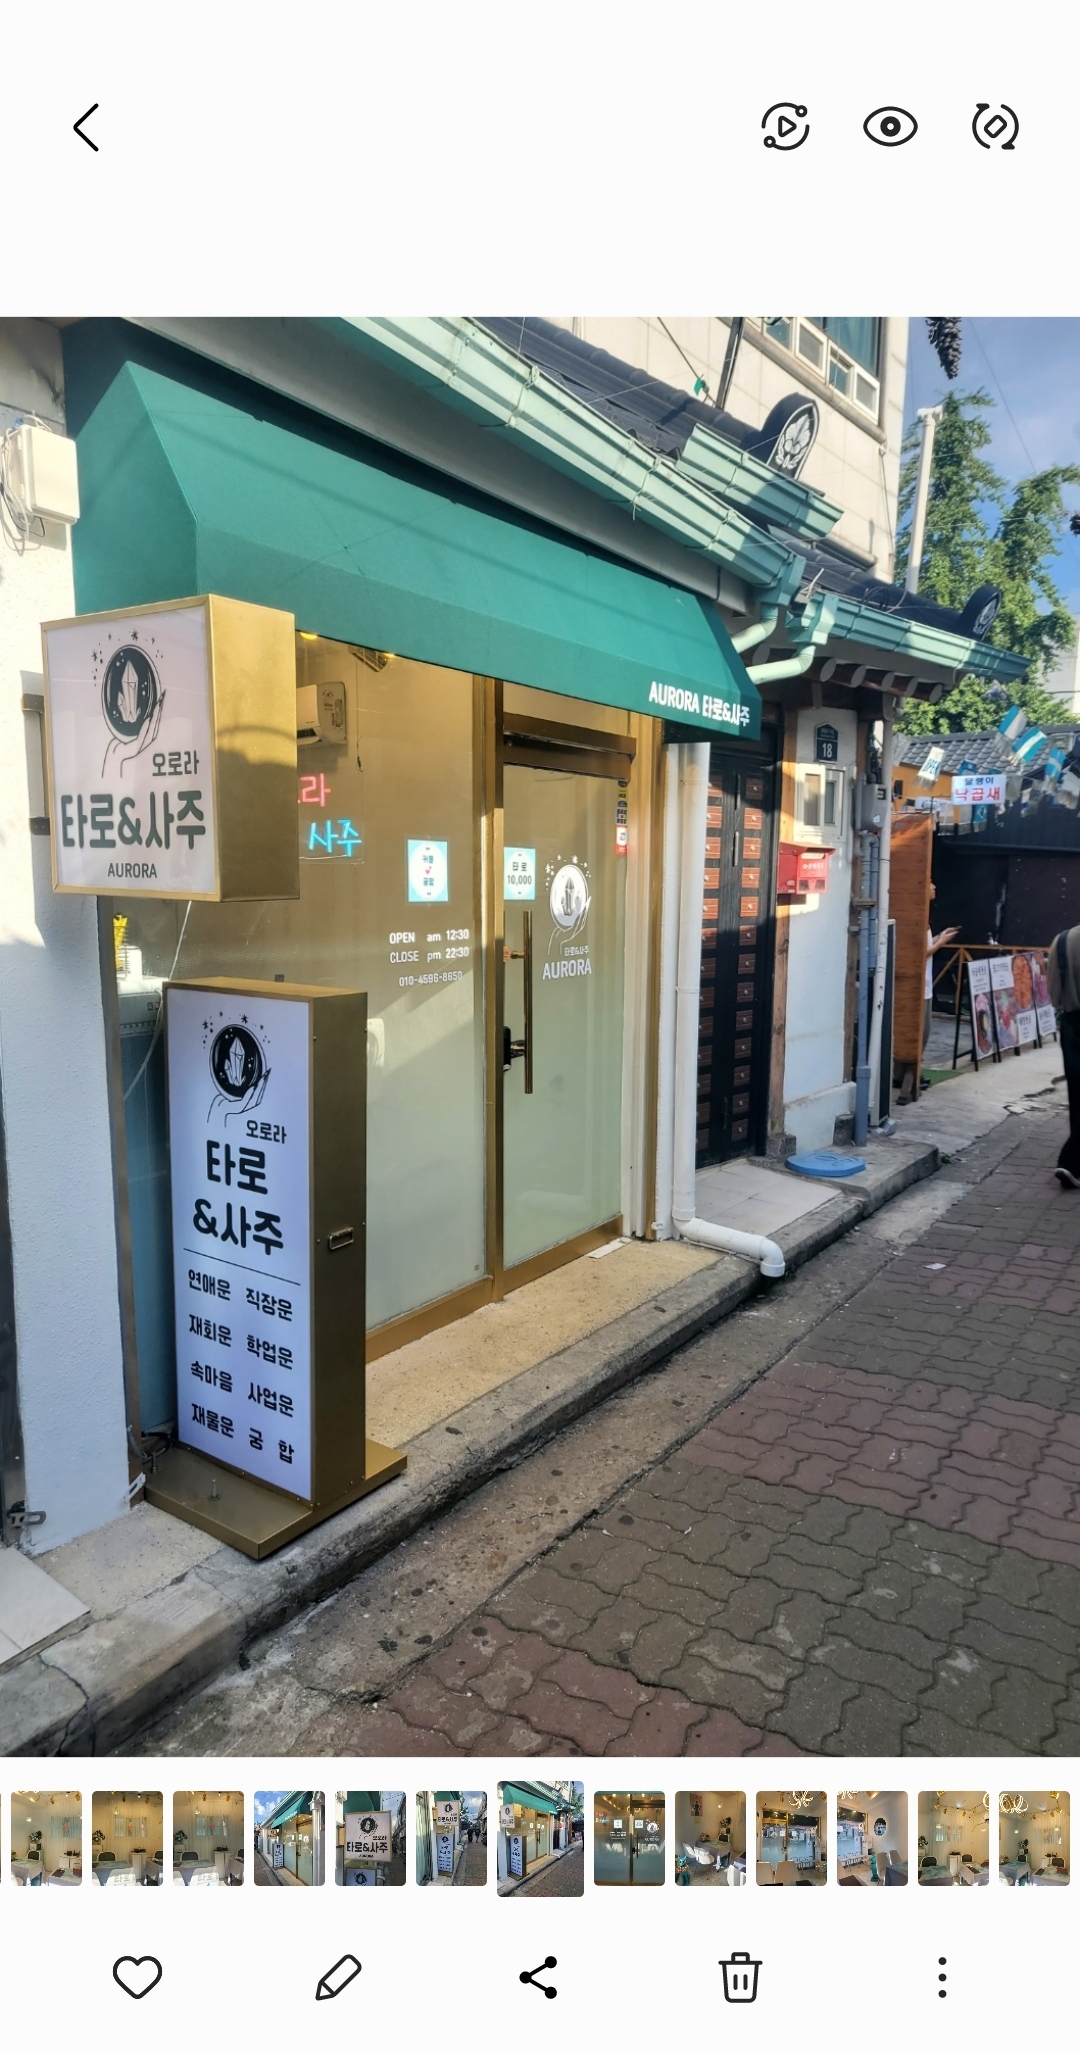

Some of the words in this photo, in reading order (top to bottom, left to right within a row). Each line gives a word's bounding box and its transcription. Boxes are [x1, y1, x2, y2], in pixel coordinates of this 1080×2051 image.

[648, 680, 700, 714] AURORA
[702, 694, 750, 727] 타로&사주
[152, 749, 200, 777] 오로라
[822, 742, 833, 758] 18
[297, 773, 331, 807] 라
[956, 787, 1000, 802] 낙곱새
[60, 789, 206, 850] 타로&사주
[107, 862, 158, 879] AURORA
[507, 874, 533, 886] 10,000
[390, 932, 415, 944] OPEN
[427, 933, 441, 942] am
[446, 929, 469, 941] 12:30
[390, 951, 419, 963] CLOSE
[427, 952, 441, 962] pm
[446, 947, 469, 959] 22:30
[542, 958, 592, 981] AURORA
[245, 1119, 288, 1145] 오로라
[205, 1138, 269, 1196] 타로
[192, 1198, 285, 1256] &사주
[188, 1268, 232, 1302] 연애운
[245, 1286, 294, 1322] 직장운
[188, 1313, 233, 1348] 재회운
[246, 1333, 294, 1370] 학업운
[190, 1360, 234, 1393] 속마음
[247, 1381, 294, 1418] 사업운
[191, 1402, 235, 1439] 재물운
[346, 1841, 389, 1854] 타로&사주
